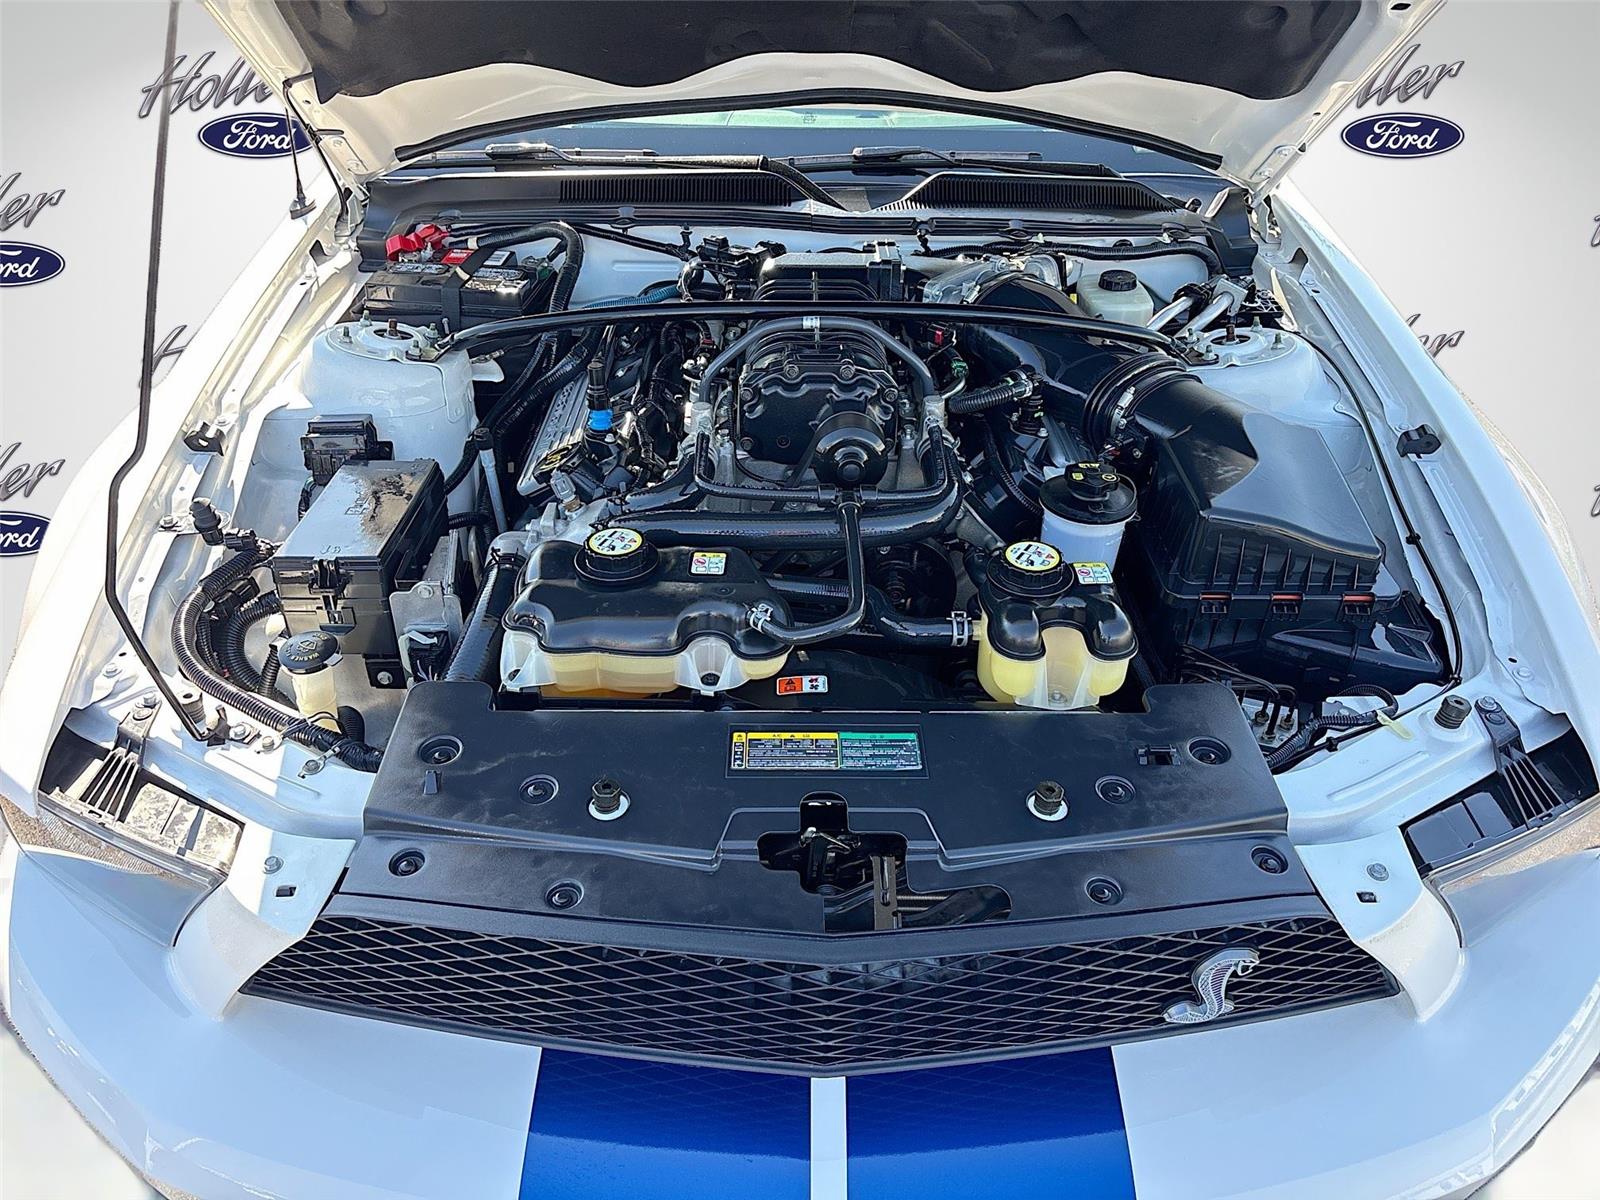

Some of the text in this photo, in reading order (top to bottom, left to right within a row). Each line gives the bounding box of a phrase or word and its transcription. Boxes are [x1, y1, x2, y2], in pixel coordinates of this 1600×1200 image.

[138, 51, 273, 119] Holl
[1356, 44, 1465, 109] ller
[223, 119, 297, 150] Ford
[1366, 119, 1440, 150] Ford
